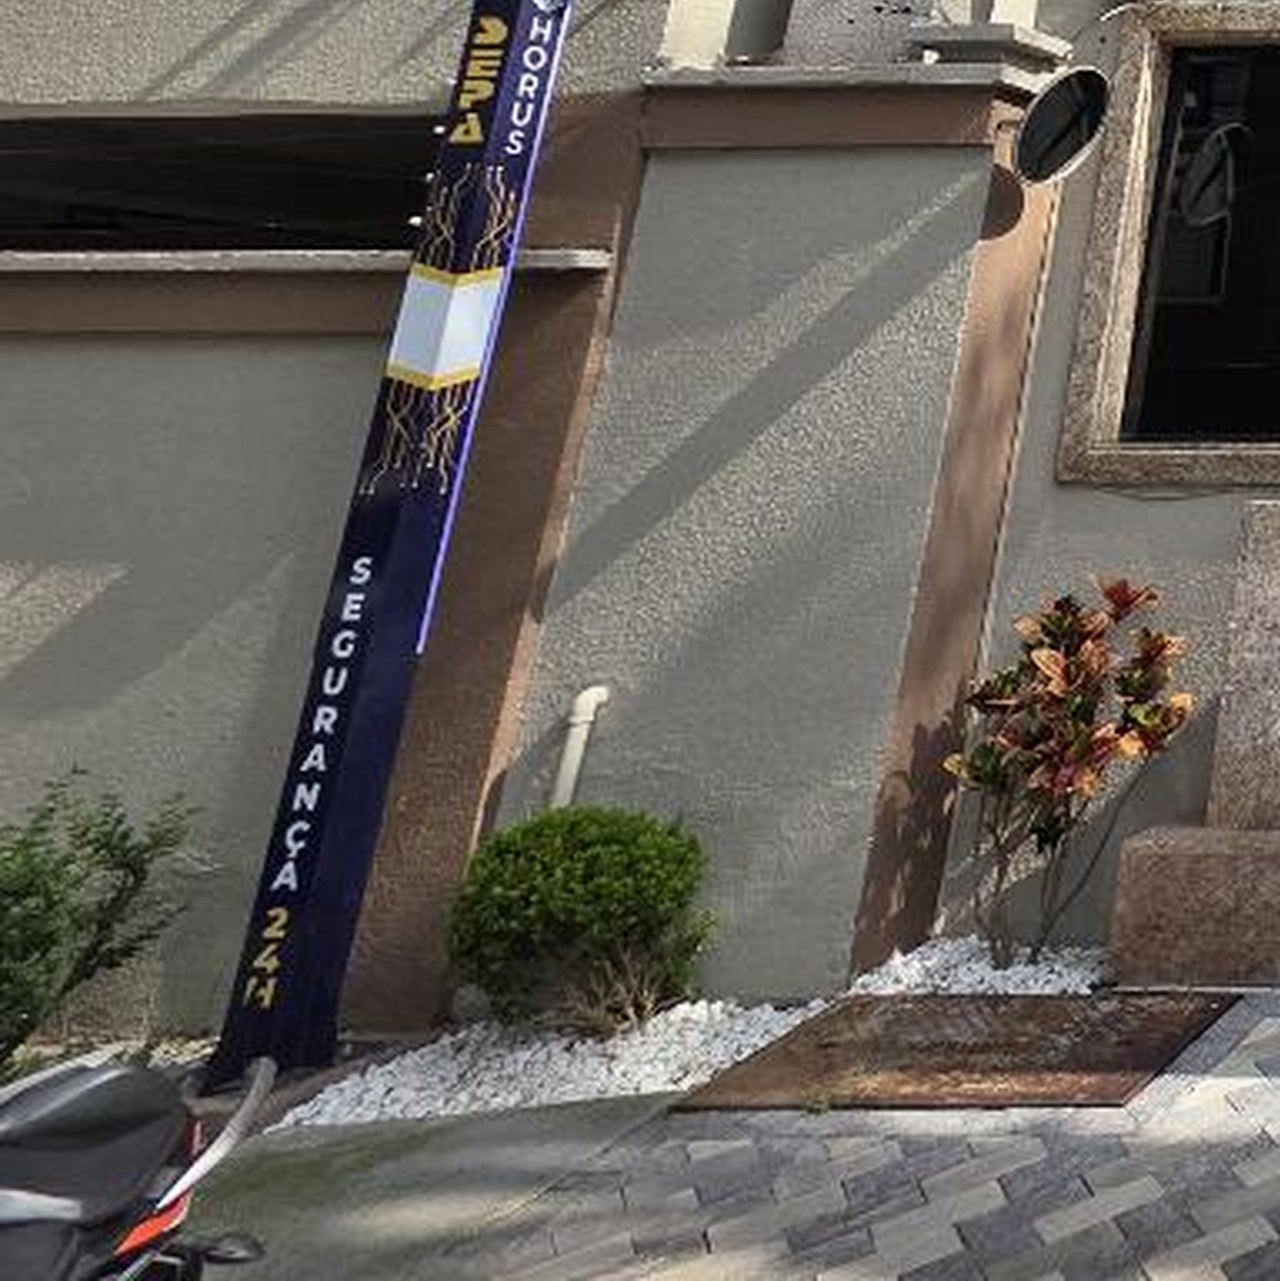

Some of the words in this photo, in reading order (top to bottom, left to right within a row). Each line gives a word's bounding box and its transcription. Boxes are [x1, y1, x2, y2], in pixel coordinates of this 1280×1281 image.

[505, 17, 553, 154] HORUS
[271, 556, 373, 891] SEGURANÇA
[243, 907, 289, 1008] 24H
